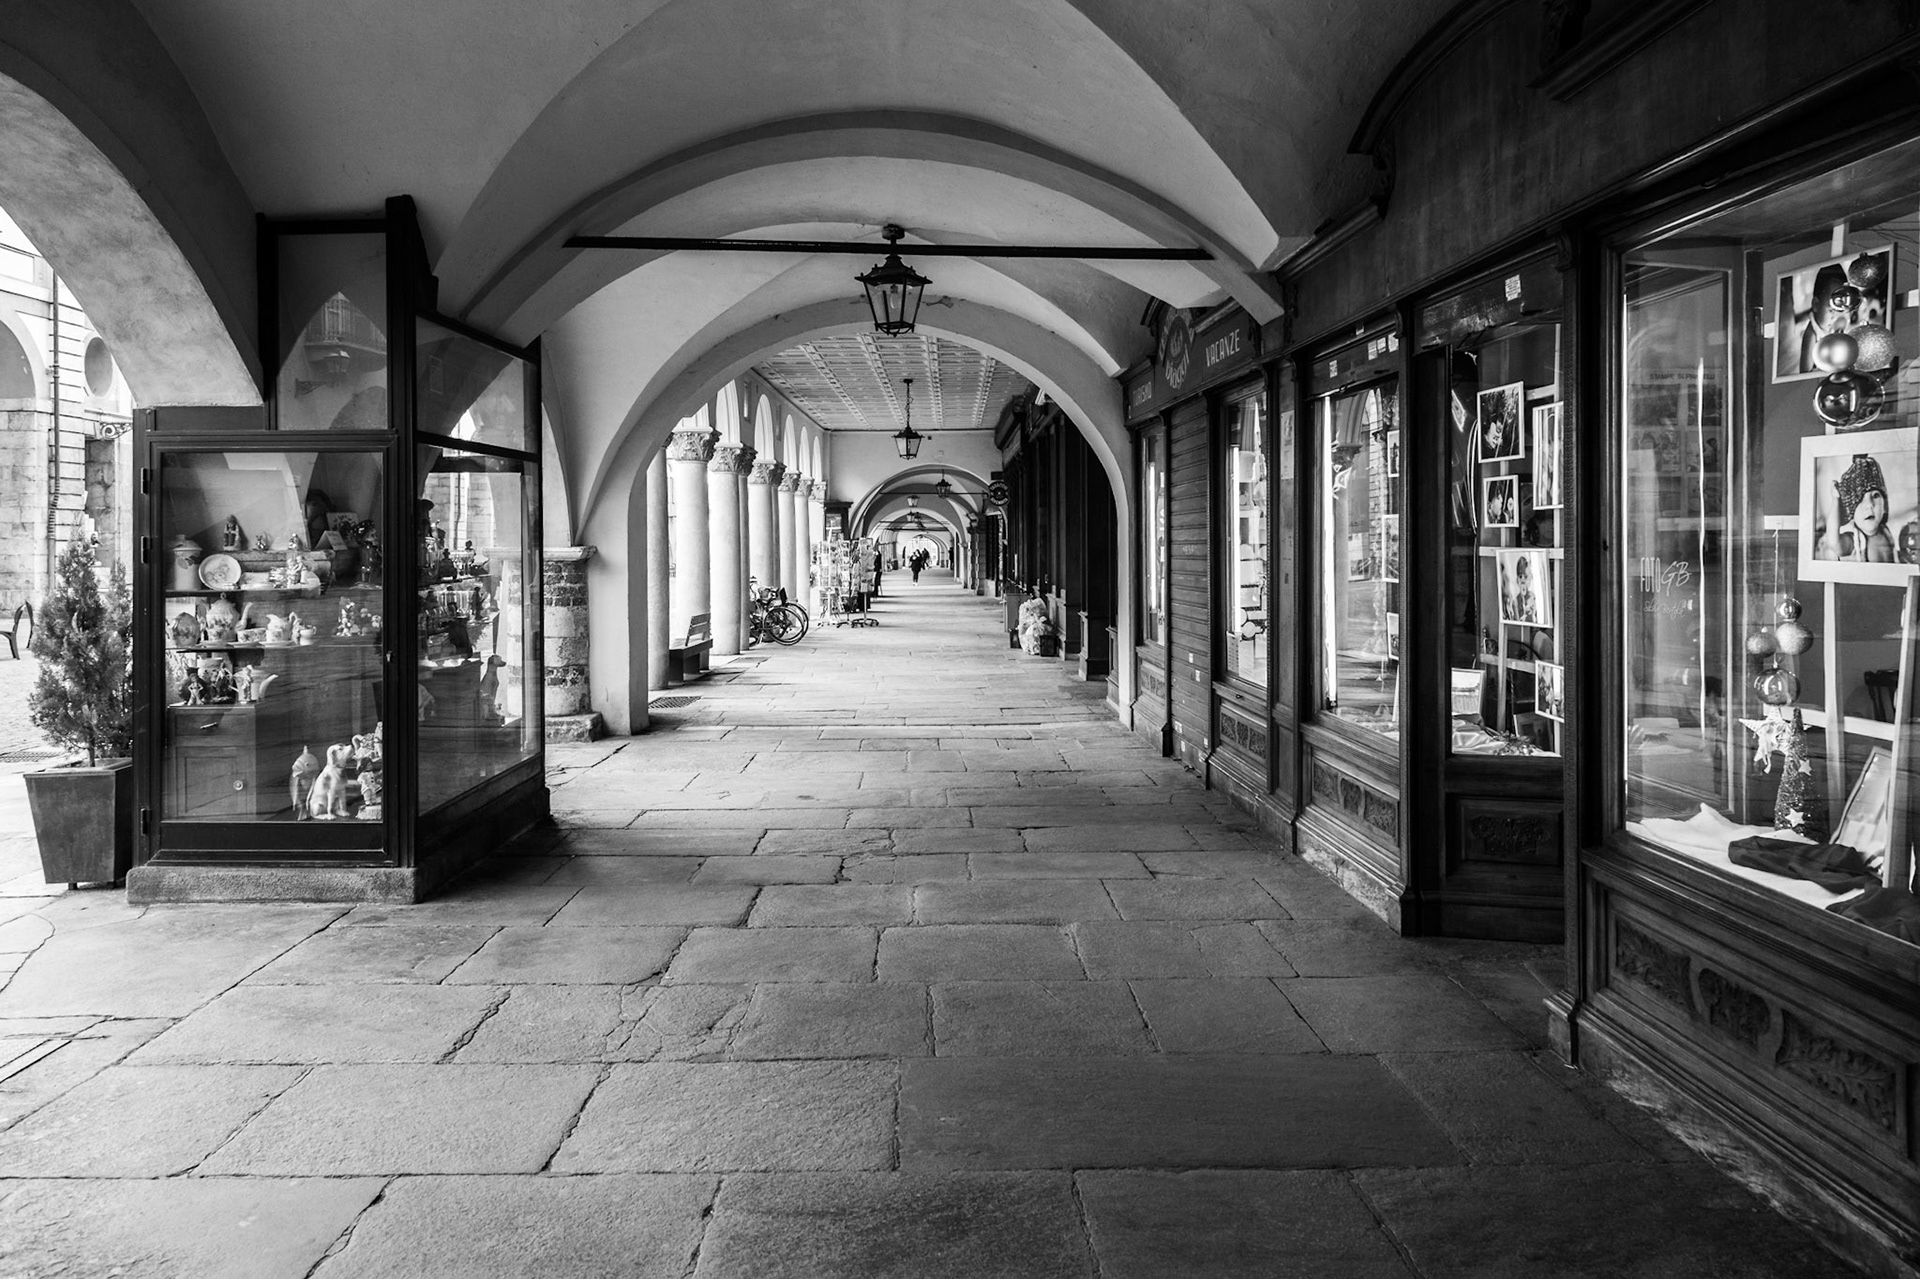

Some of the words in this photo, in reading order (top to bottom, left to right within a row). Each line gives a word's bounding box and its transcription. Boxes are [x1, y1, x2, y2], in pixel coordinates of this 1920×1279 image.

[1206, 329, 1240, 367] VACANZE
[1641, 557, 1660, 592] FOTO
[1661, 561, 1692, 596] GB
